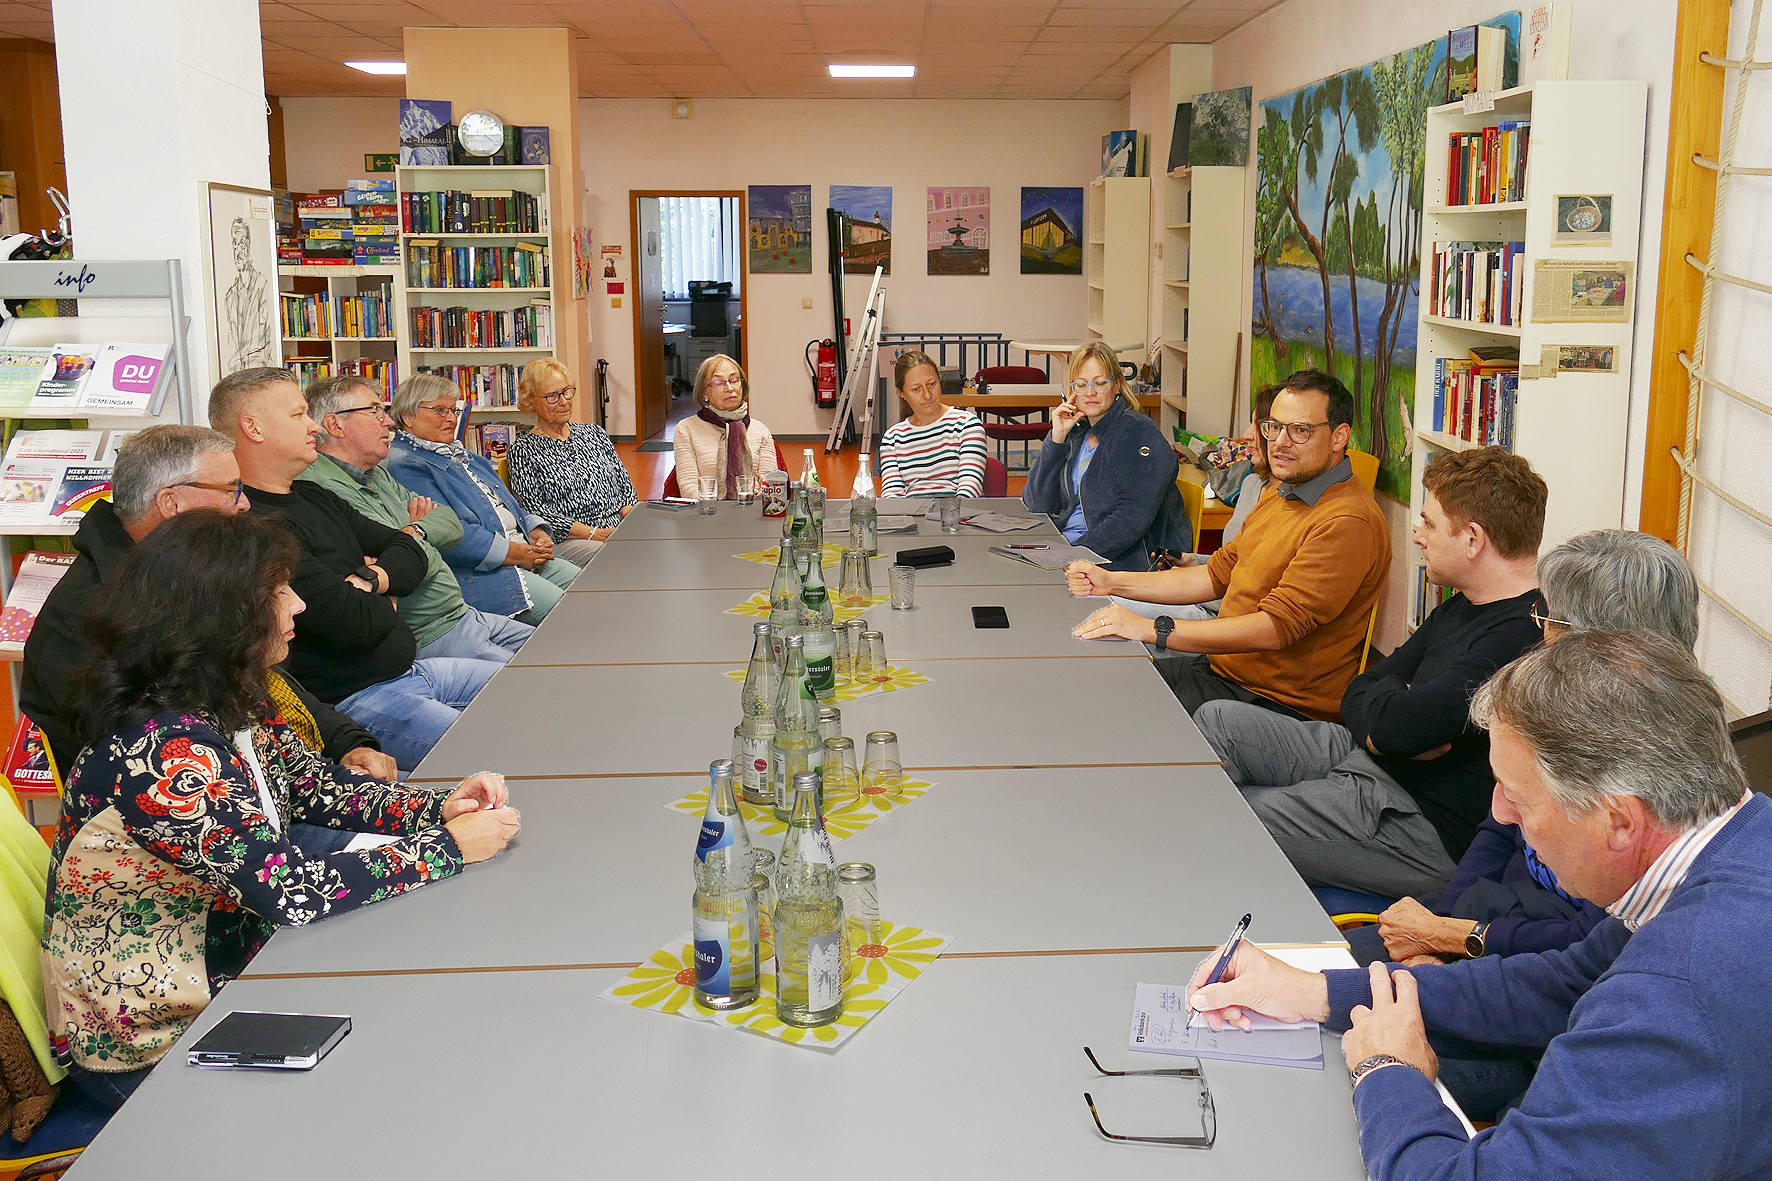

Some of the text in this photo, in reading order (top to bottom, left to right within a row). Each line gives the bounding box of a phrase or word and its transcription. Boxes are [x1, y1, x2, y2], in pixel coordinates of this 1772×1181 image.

[54, 263, 96, 293] info
[121, 364, 155, 379] DU
[86, 397, 134, 406] GEMEINSAM
[39, 555, 56, 563] Der
